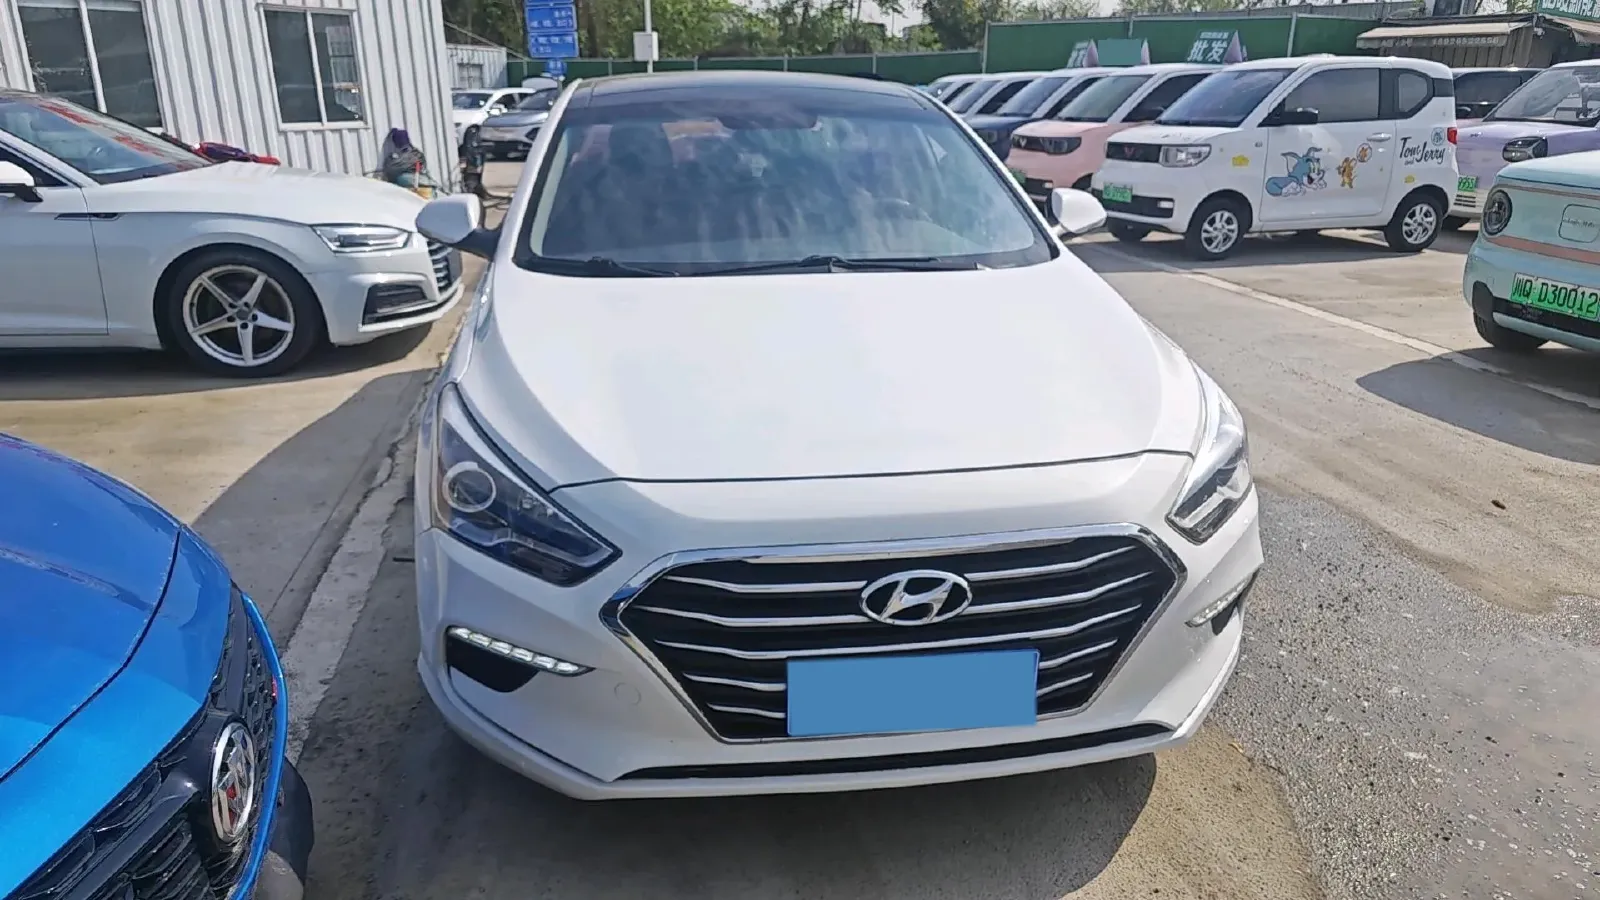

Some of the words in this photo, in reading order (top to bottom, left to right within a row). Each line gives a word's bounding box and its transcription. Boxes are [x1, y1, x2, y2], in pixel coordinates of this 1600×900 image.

[1187, 39, 1228, 62] 批发
[1399, 136, 1421, 159] Tom
[1415, 141, 1446, 165] Jerry
